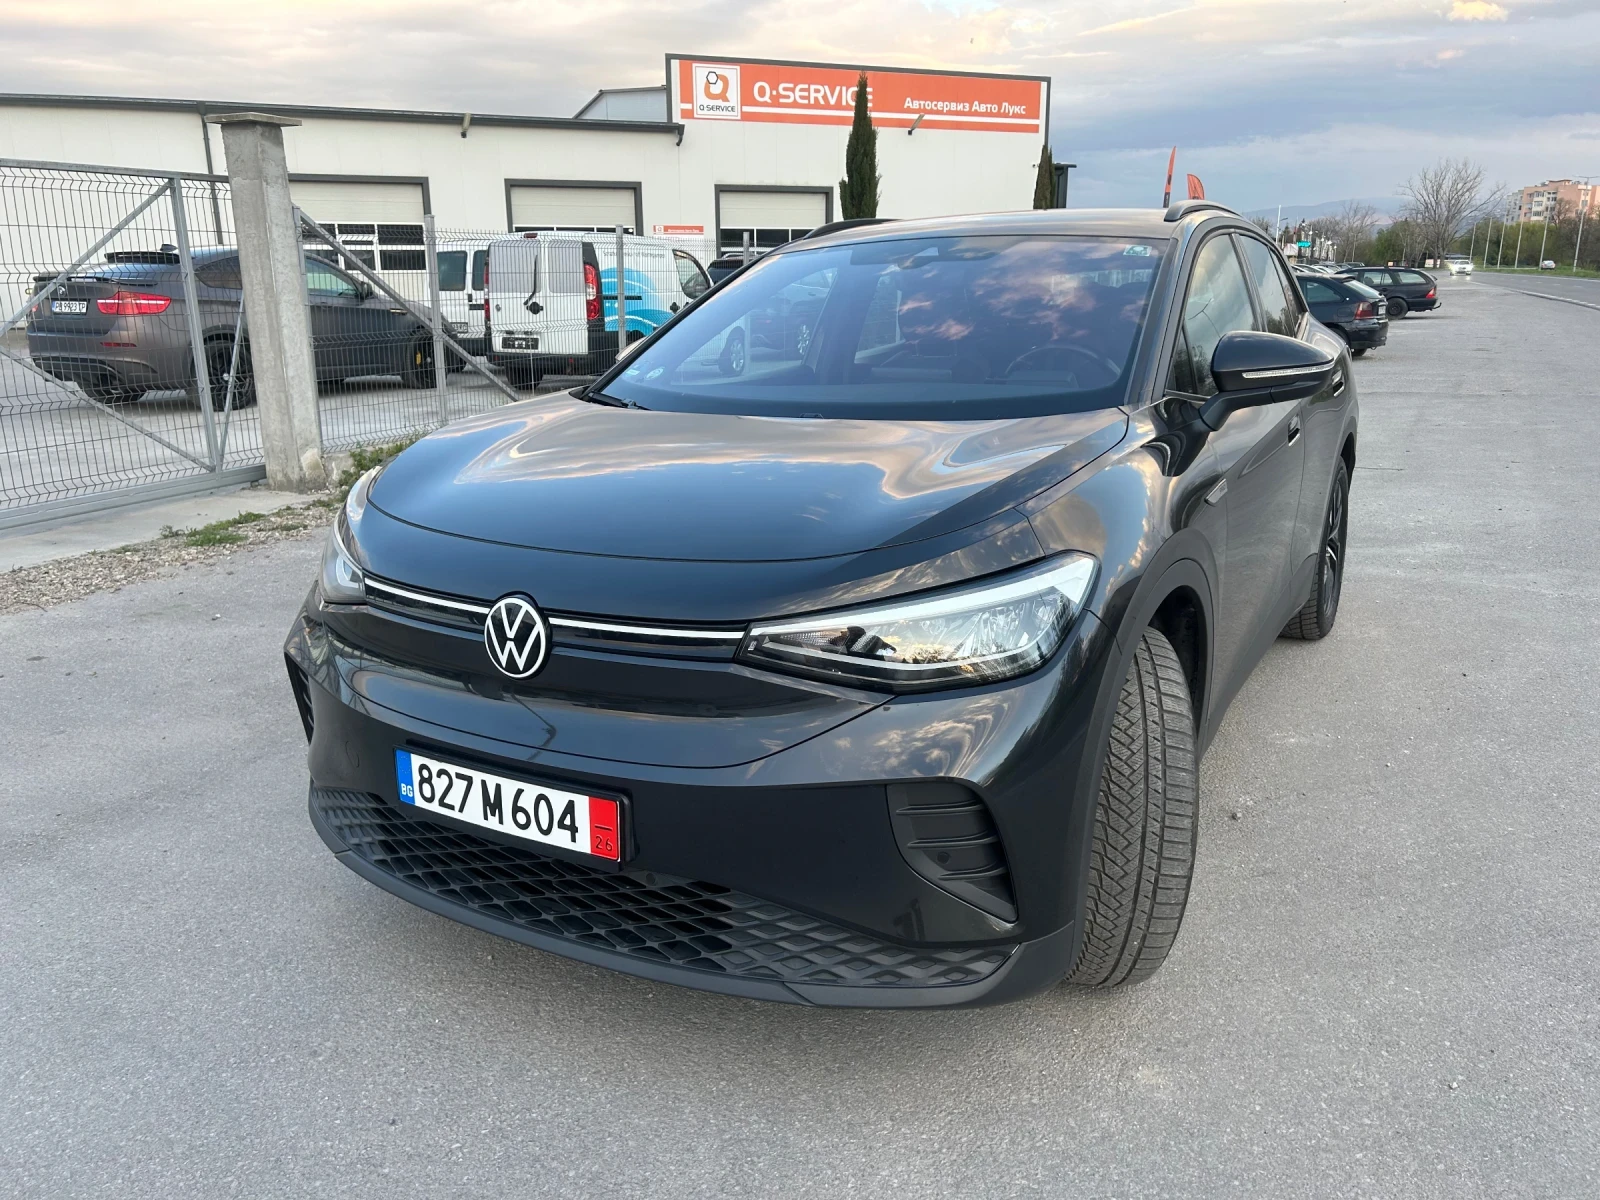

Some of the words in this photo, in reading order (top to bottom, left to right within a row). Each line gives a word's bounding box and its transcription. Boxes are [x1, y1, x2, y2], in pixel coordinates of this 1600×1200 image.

[904, 97, 970, 113] Автосервиз
[971, 101, 998, 113] Авто
[1000, 102, 1026, 116] Лукс
[401, 783, 413, 797] BG
[418, 763, 473, 813] 827
[480, 779, 504, 825] M
[511, 788, 579, 843] 604
[595, 835, 613, 852] 26
